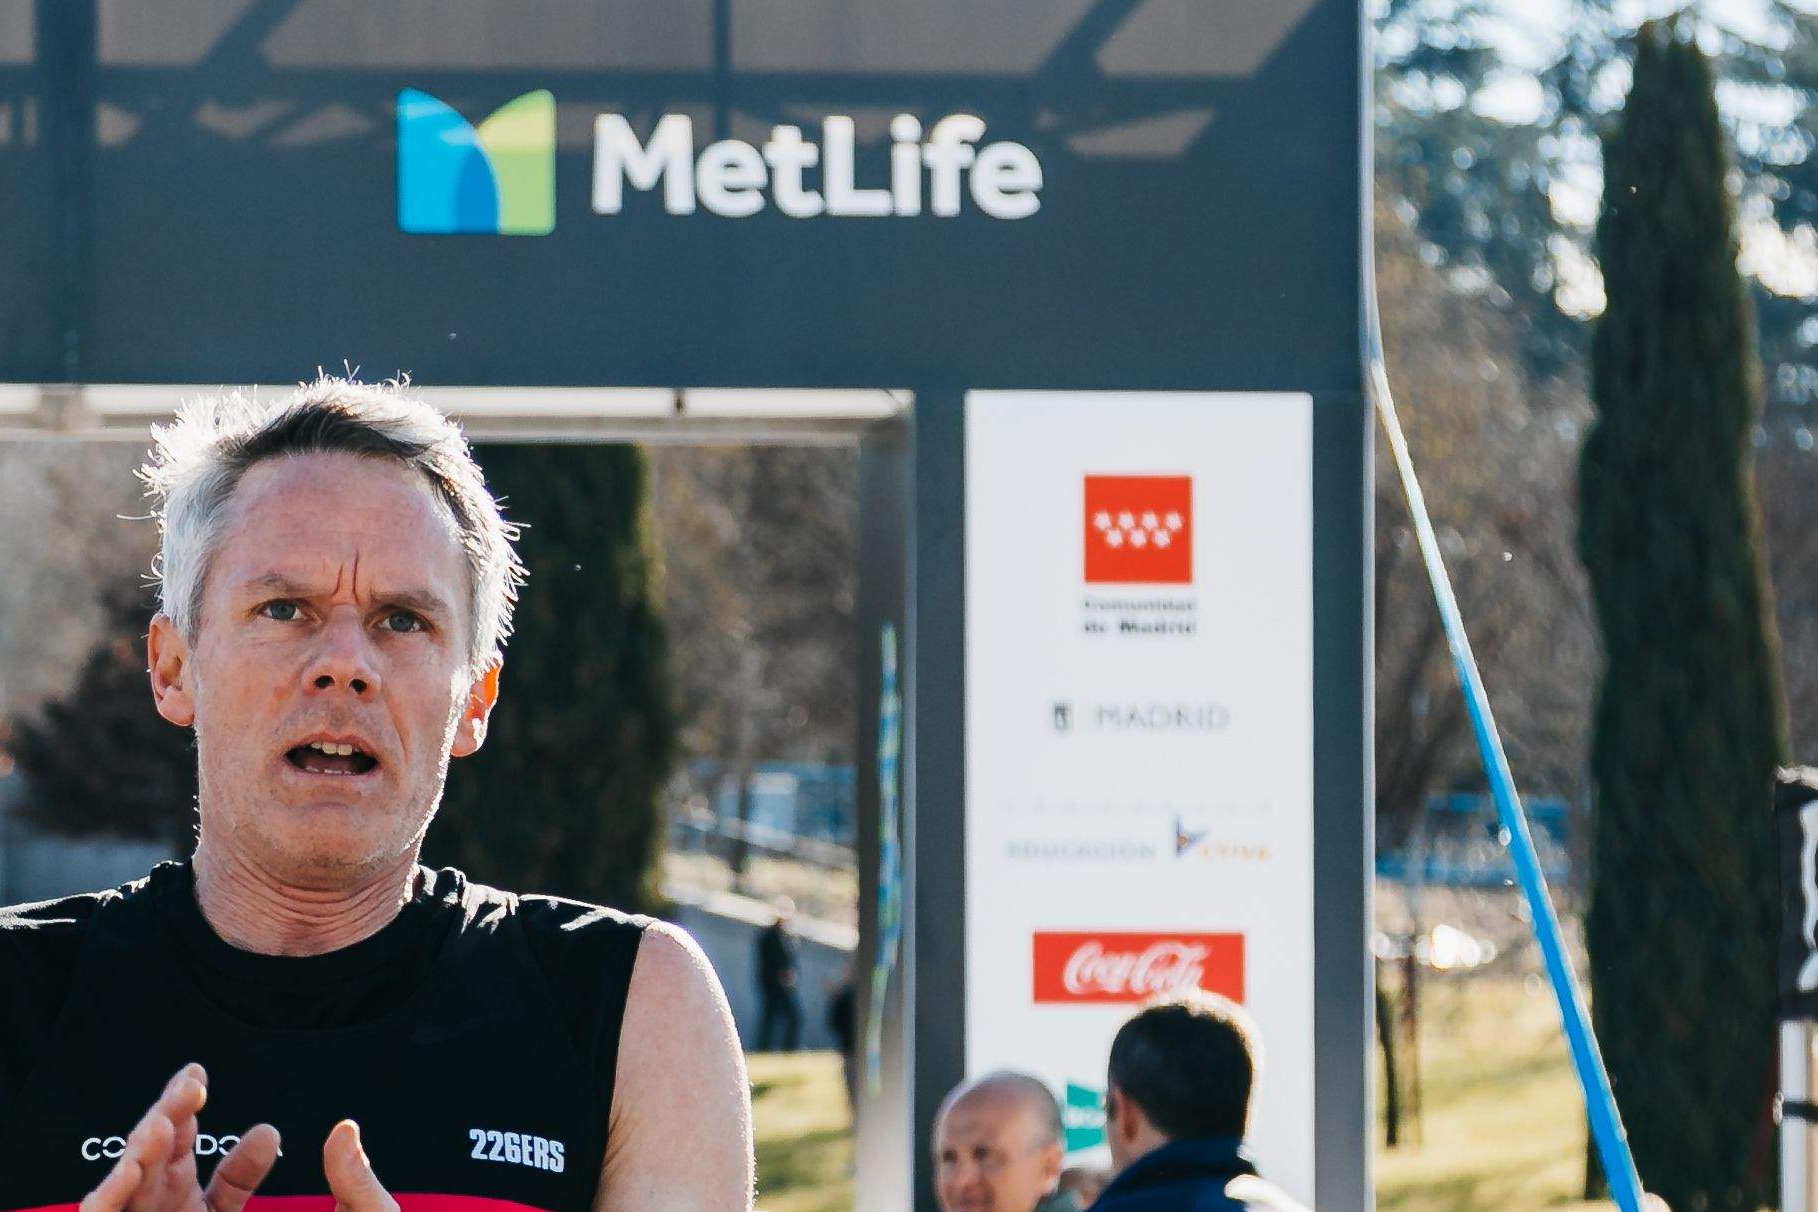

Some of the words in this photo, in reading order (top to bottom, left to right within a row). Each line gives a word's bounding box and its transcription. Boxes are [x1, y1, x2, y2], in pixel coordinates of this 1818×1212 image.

[591, 112, 1044, 220] MetLife
[1097, 702, 1230, 731] MADRID
[469, 1128, 565, 1173] 226ERS
